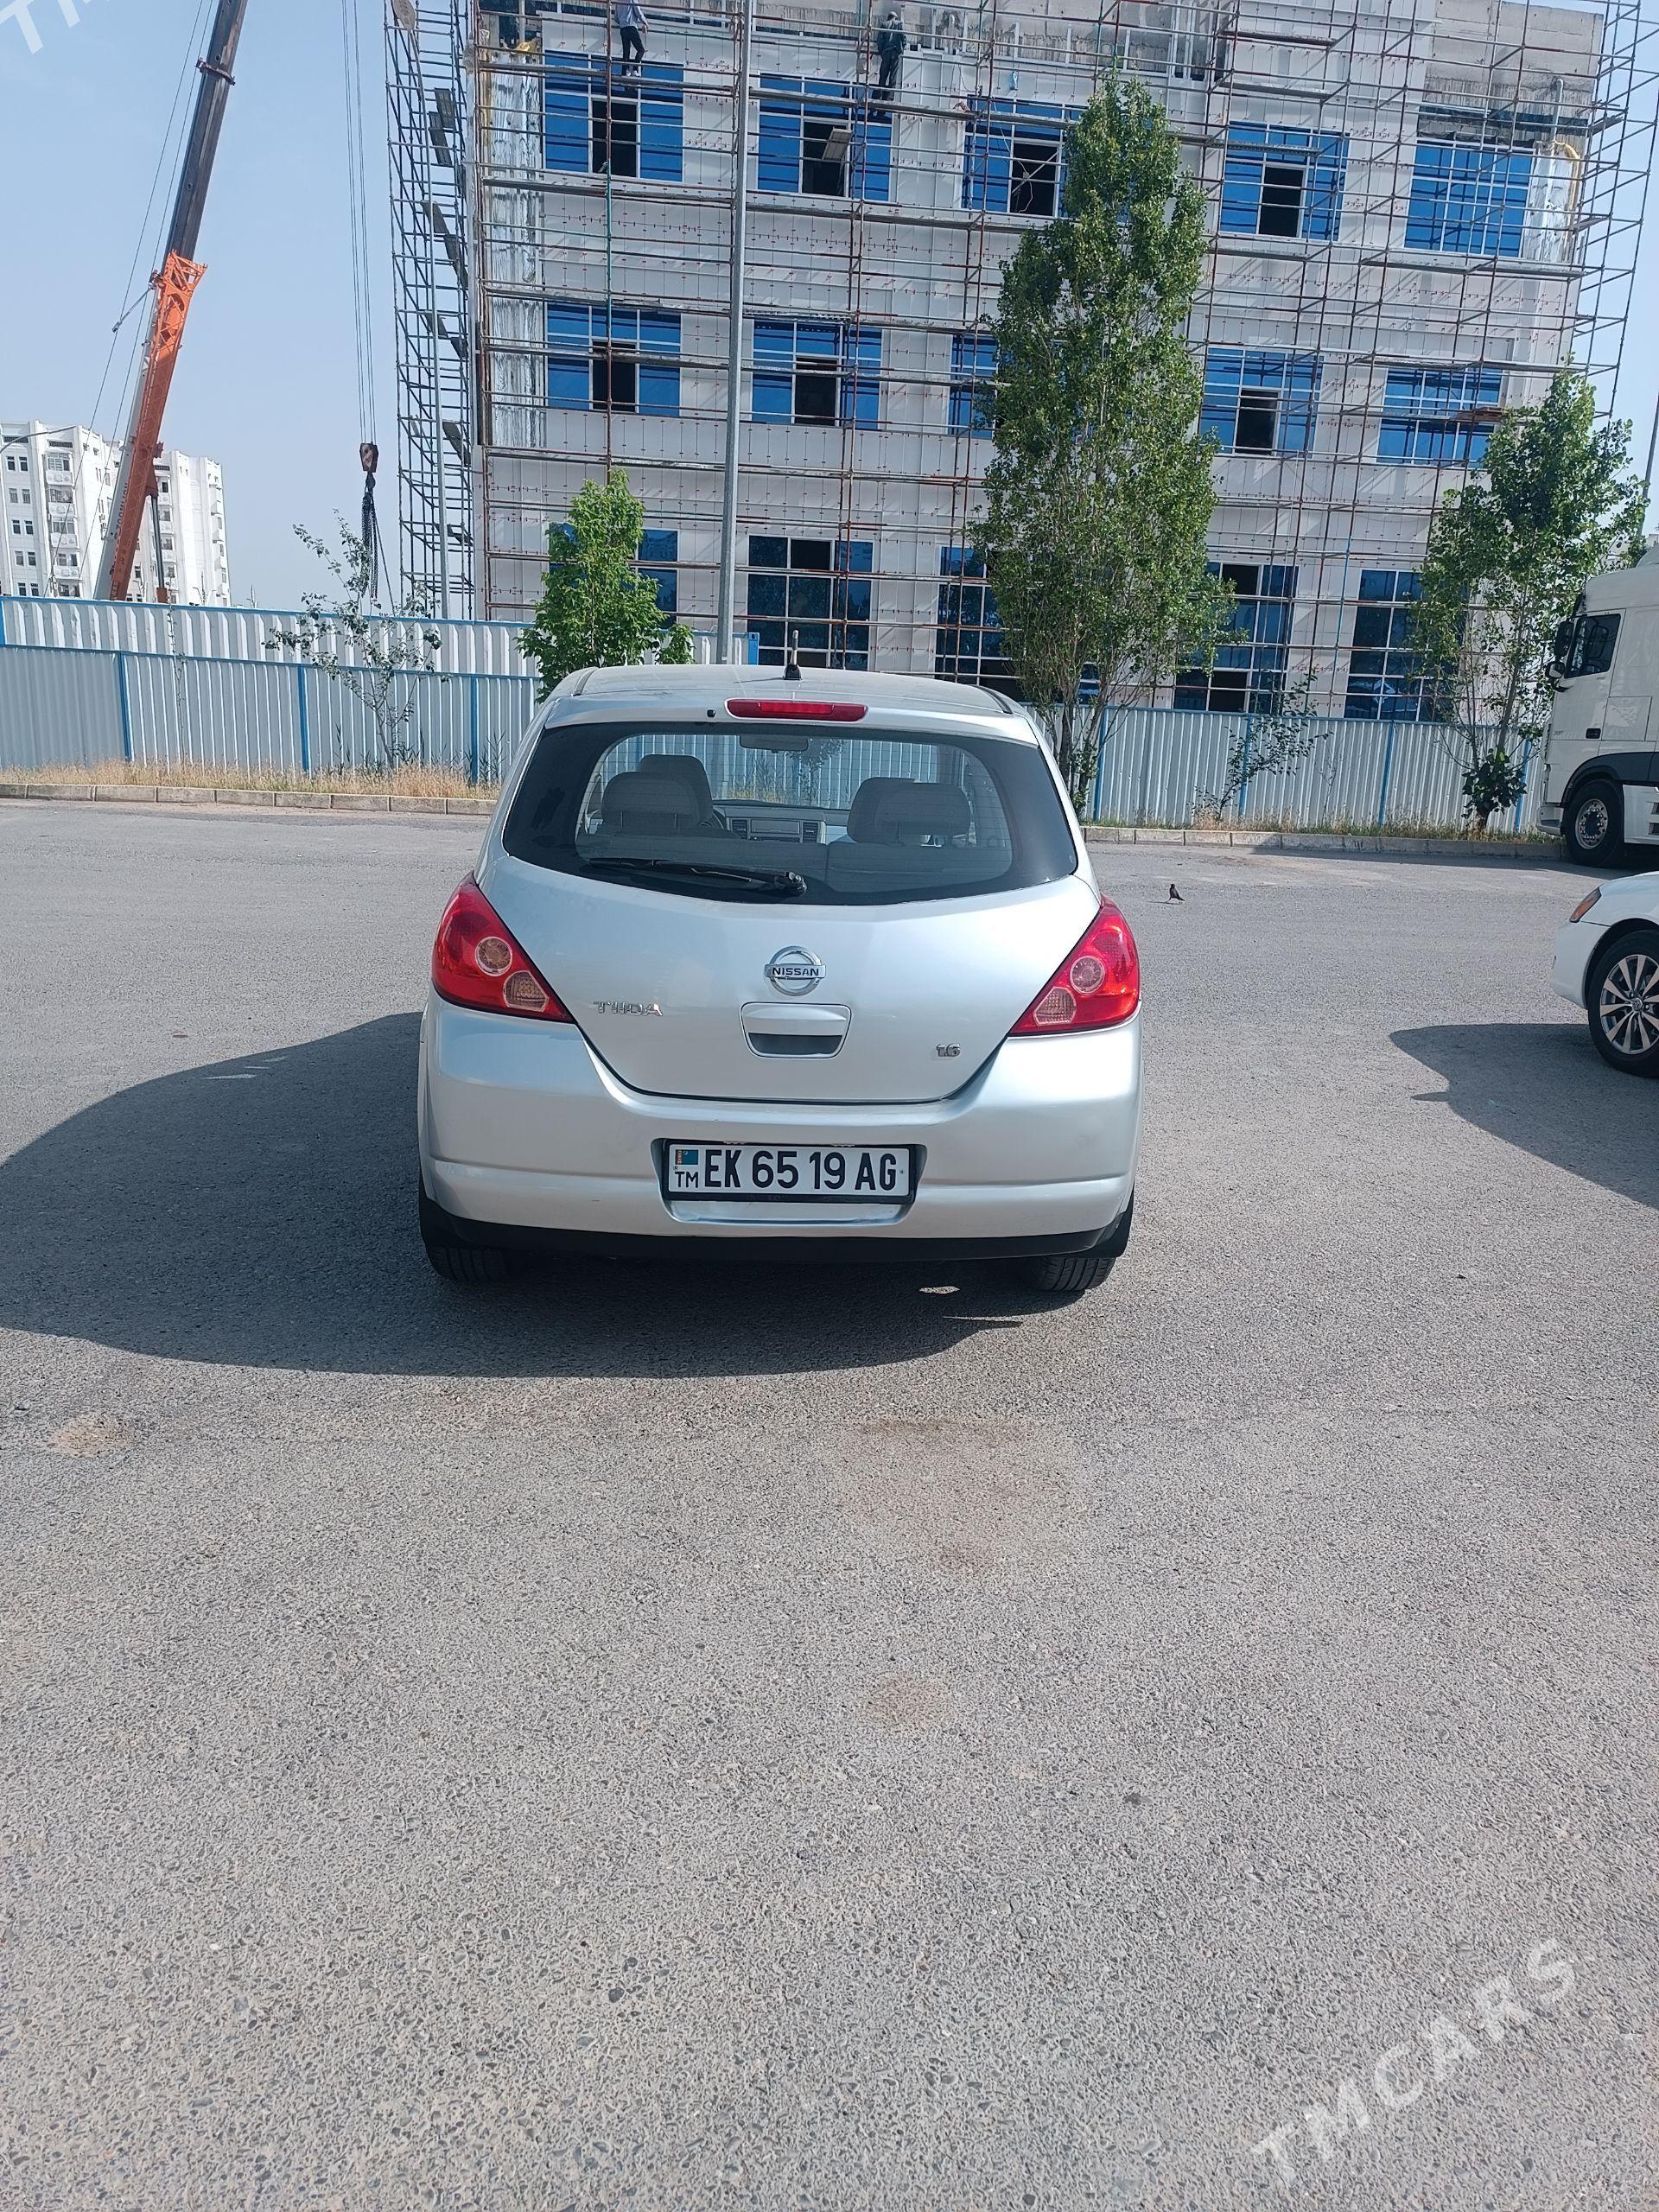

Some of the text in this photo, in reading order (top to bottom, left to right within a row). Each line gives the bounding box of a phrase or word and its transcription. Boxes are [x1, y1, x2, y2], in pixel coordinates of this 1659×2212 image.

[772, 967, 819, 976] NISSAN
[593, 1001, 663, 1016] TIIDA
[675, 1149, 897, 1192] TM EK 65 19 AG
